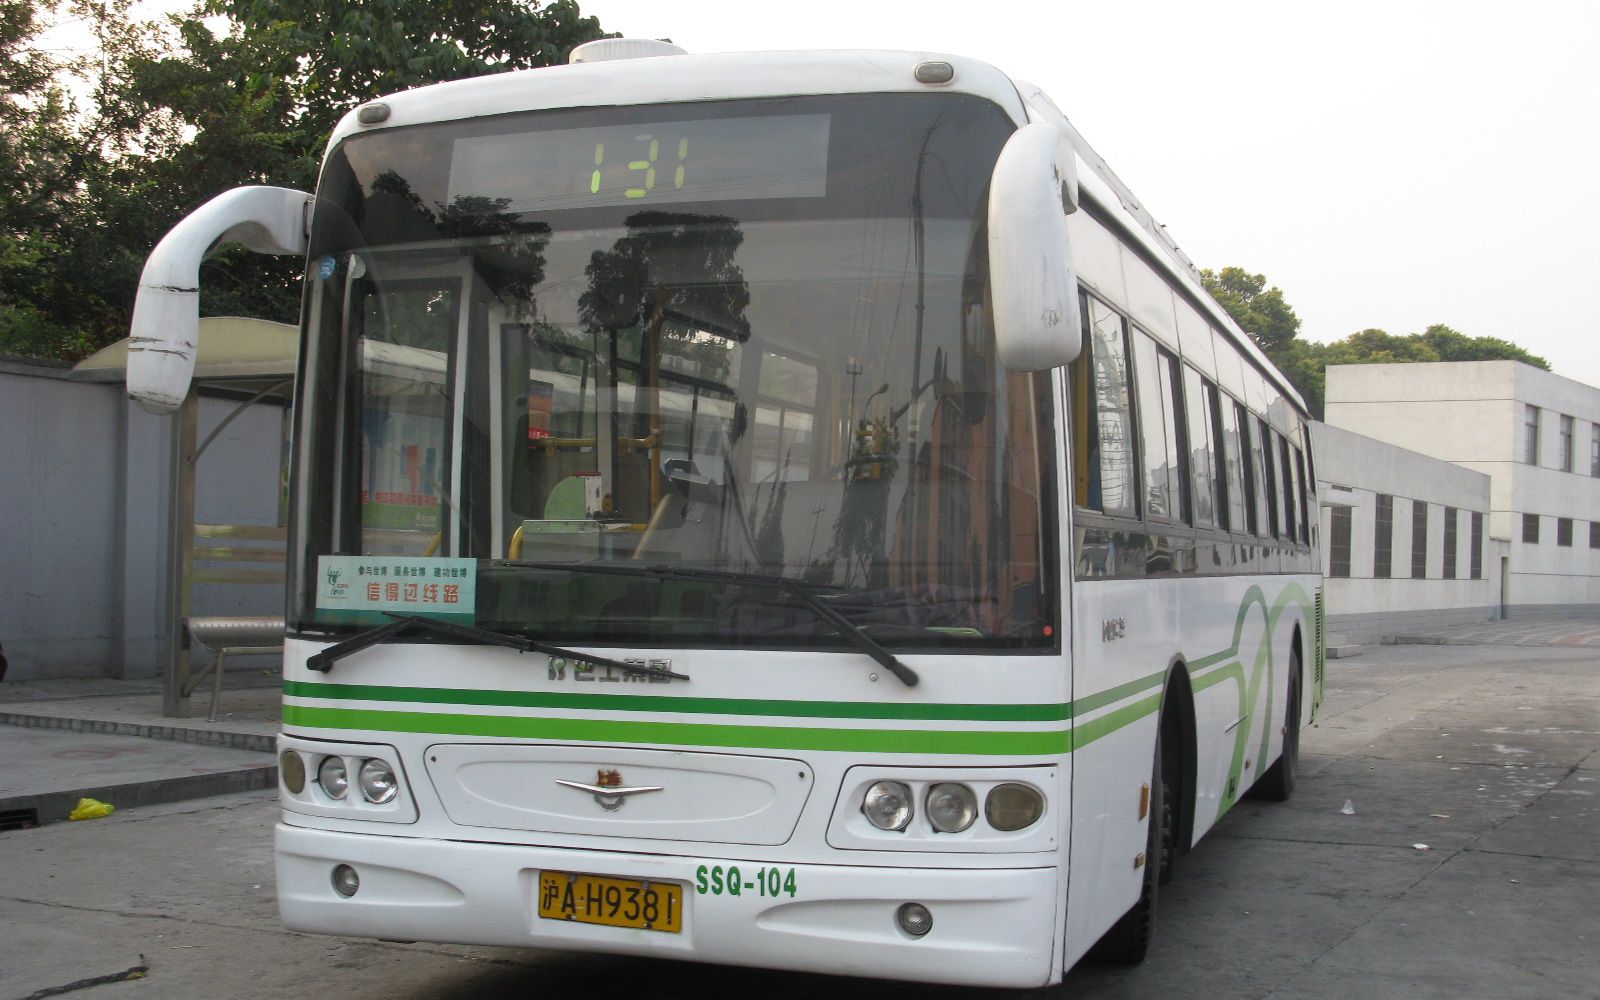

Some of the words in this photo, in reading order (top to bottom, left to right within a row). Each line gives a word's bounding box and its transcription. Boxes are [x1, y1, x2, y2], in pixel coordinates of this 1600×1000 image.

[591, 135, 689, 198] 131
[367, 582, 459, 603] 信得过线路
[696, 865, 797, 897] SSQ-104
